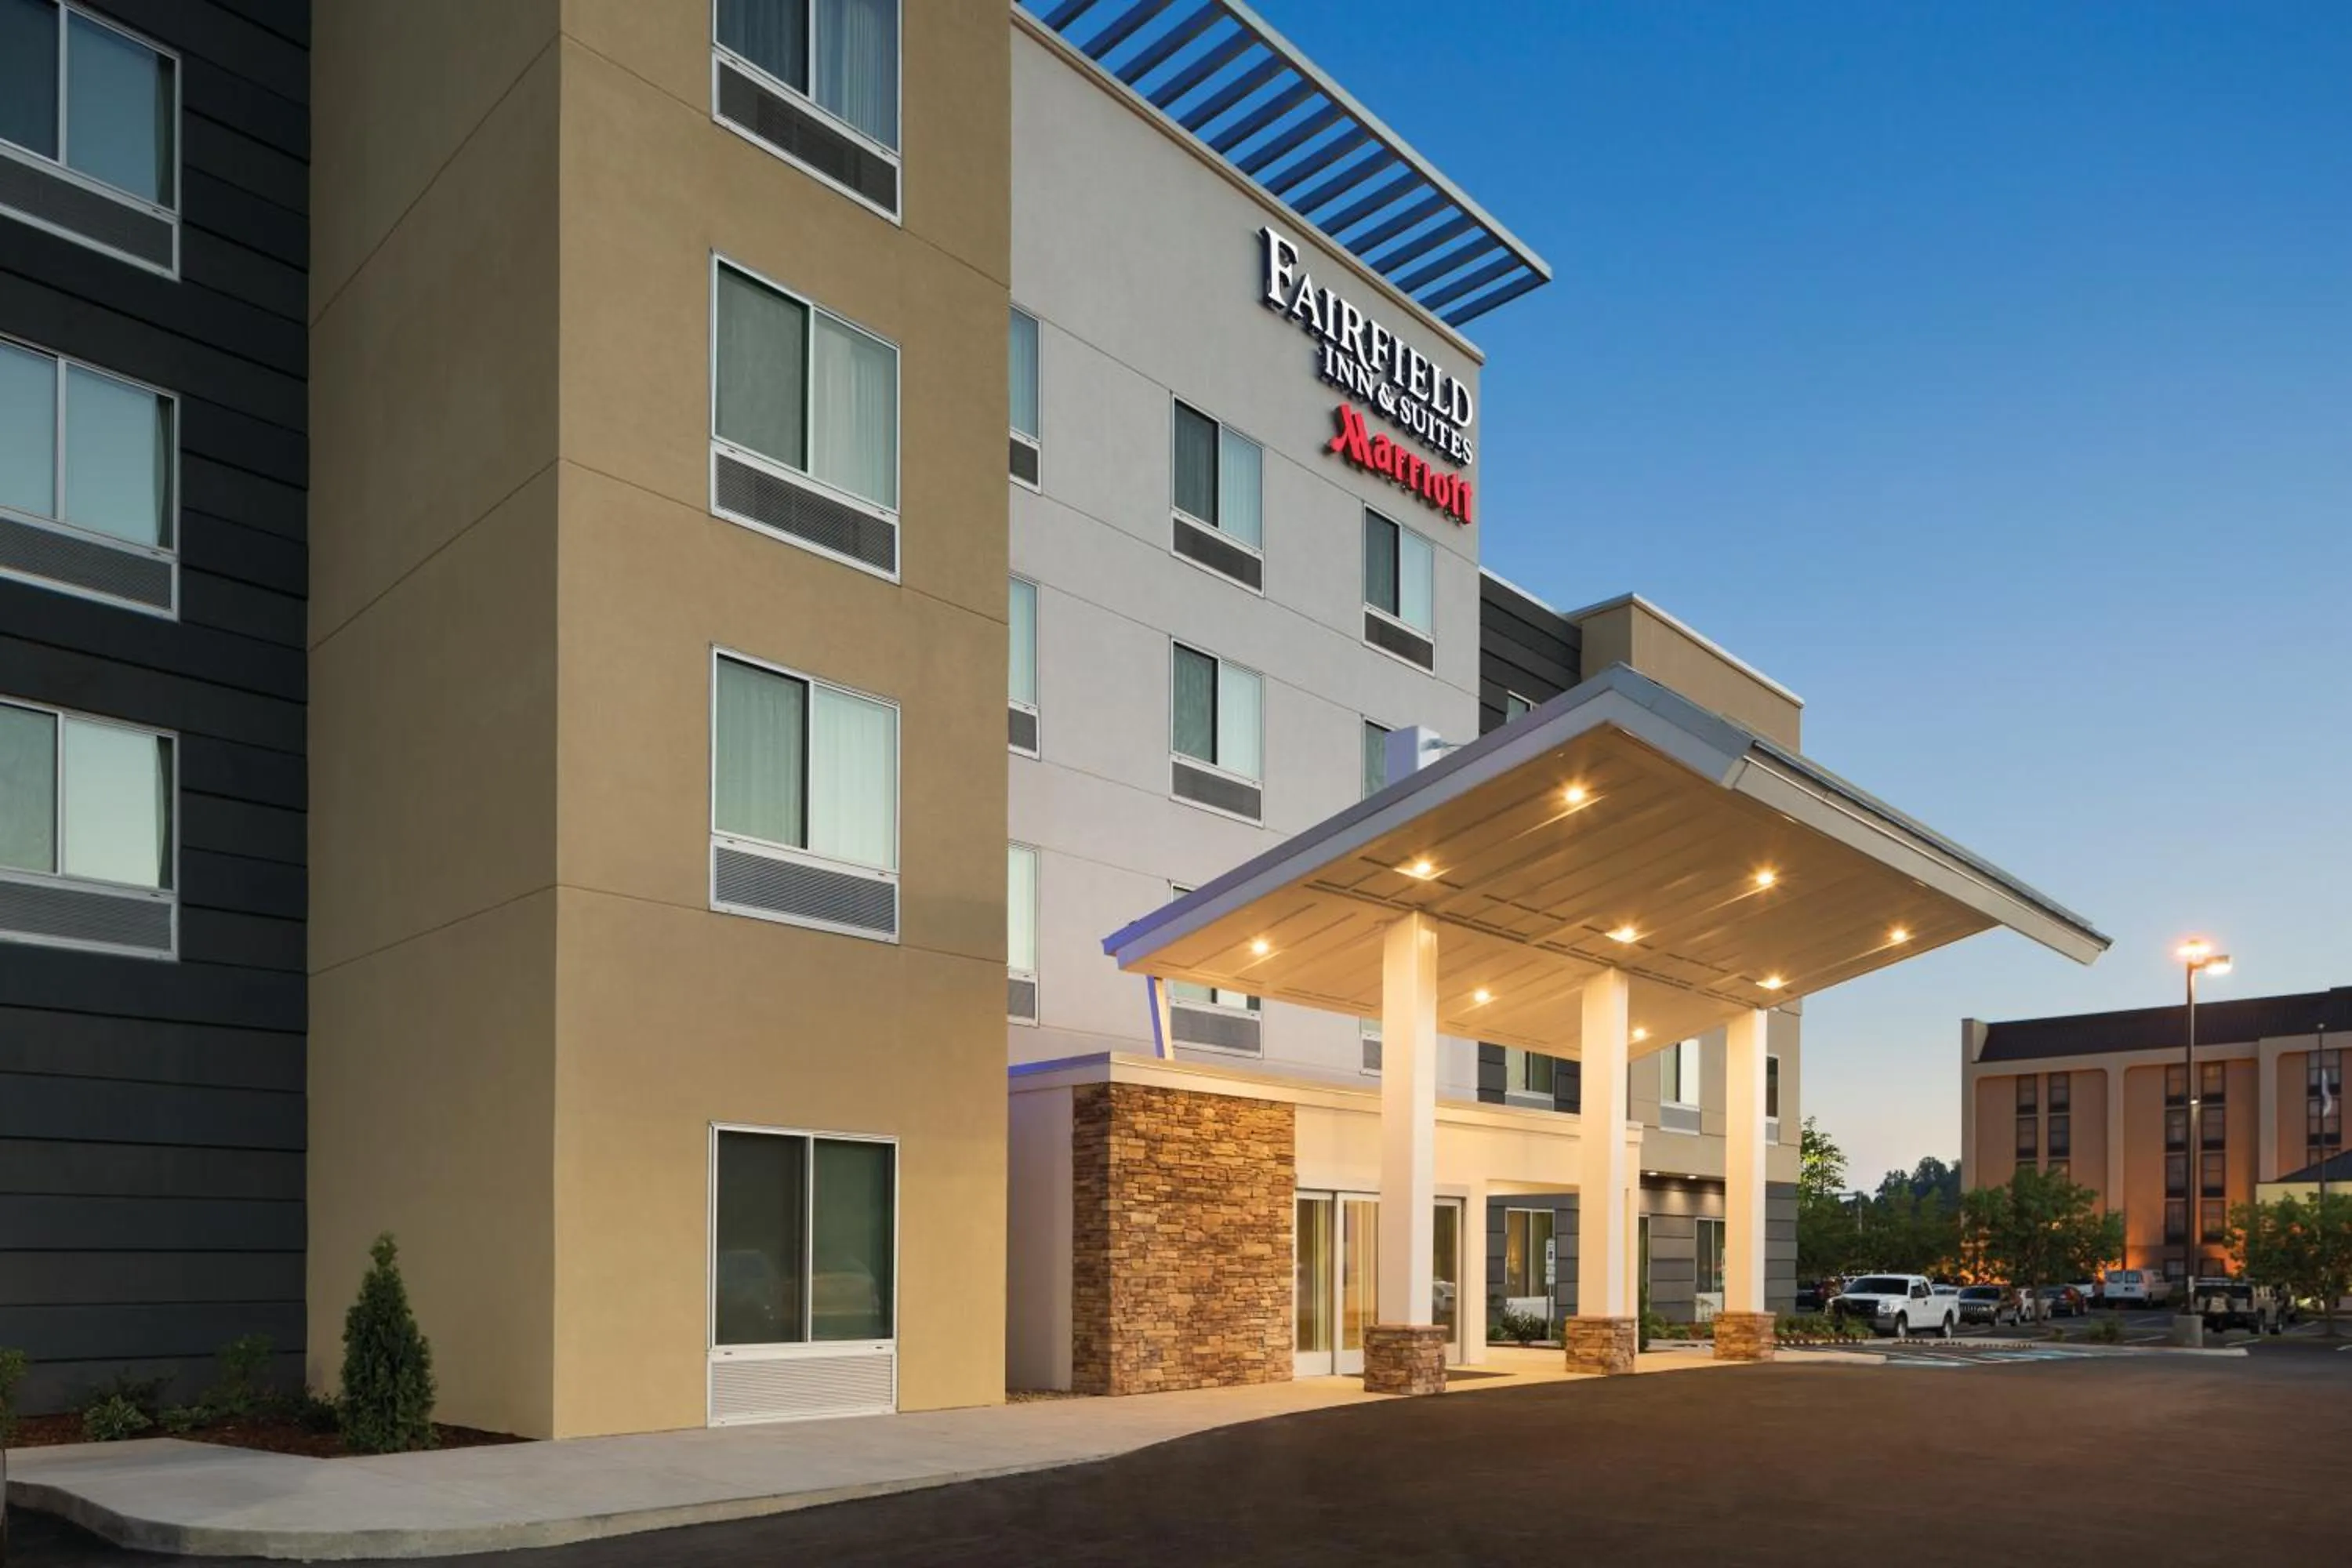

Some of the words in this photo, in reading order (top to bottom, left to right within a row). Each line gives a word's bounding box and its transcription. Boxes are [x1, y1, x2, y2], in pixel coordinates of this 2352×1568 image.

[1258, 225, 1474, 428] FAIRFIELD
[1323, 343, 1374, 403] INN
[1377, 381, 1396, 416] &
[1399, 395, 1474, 466] SUITES
[1329, 403, 1474, 524] Marriott
